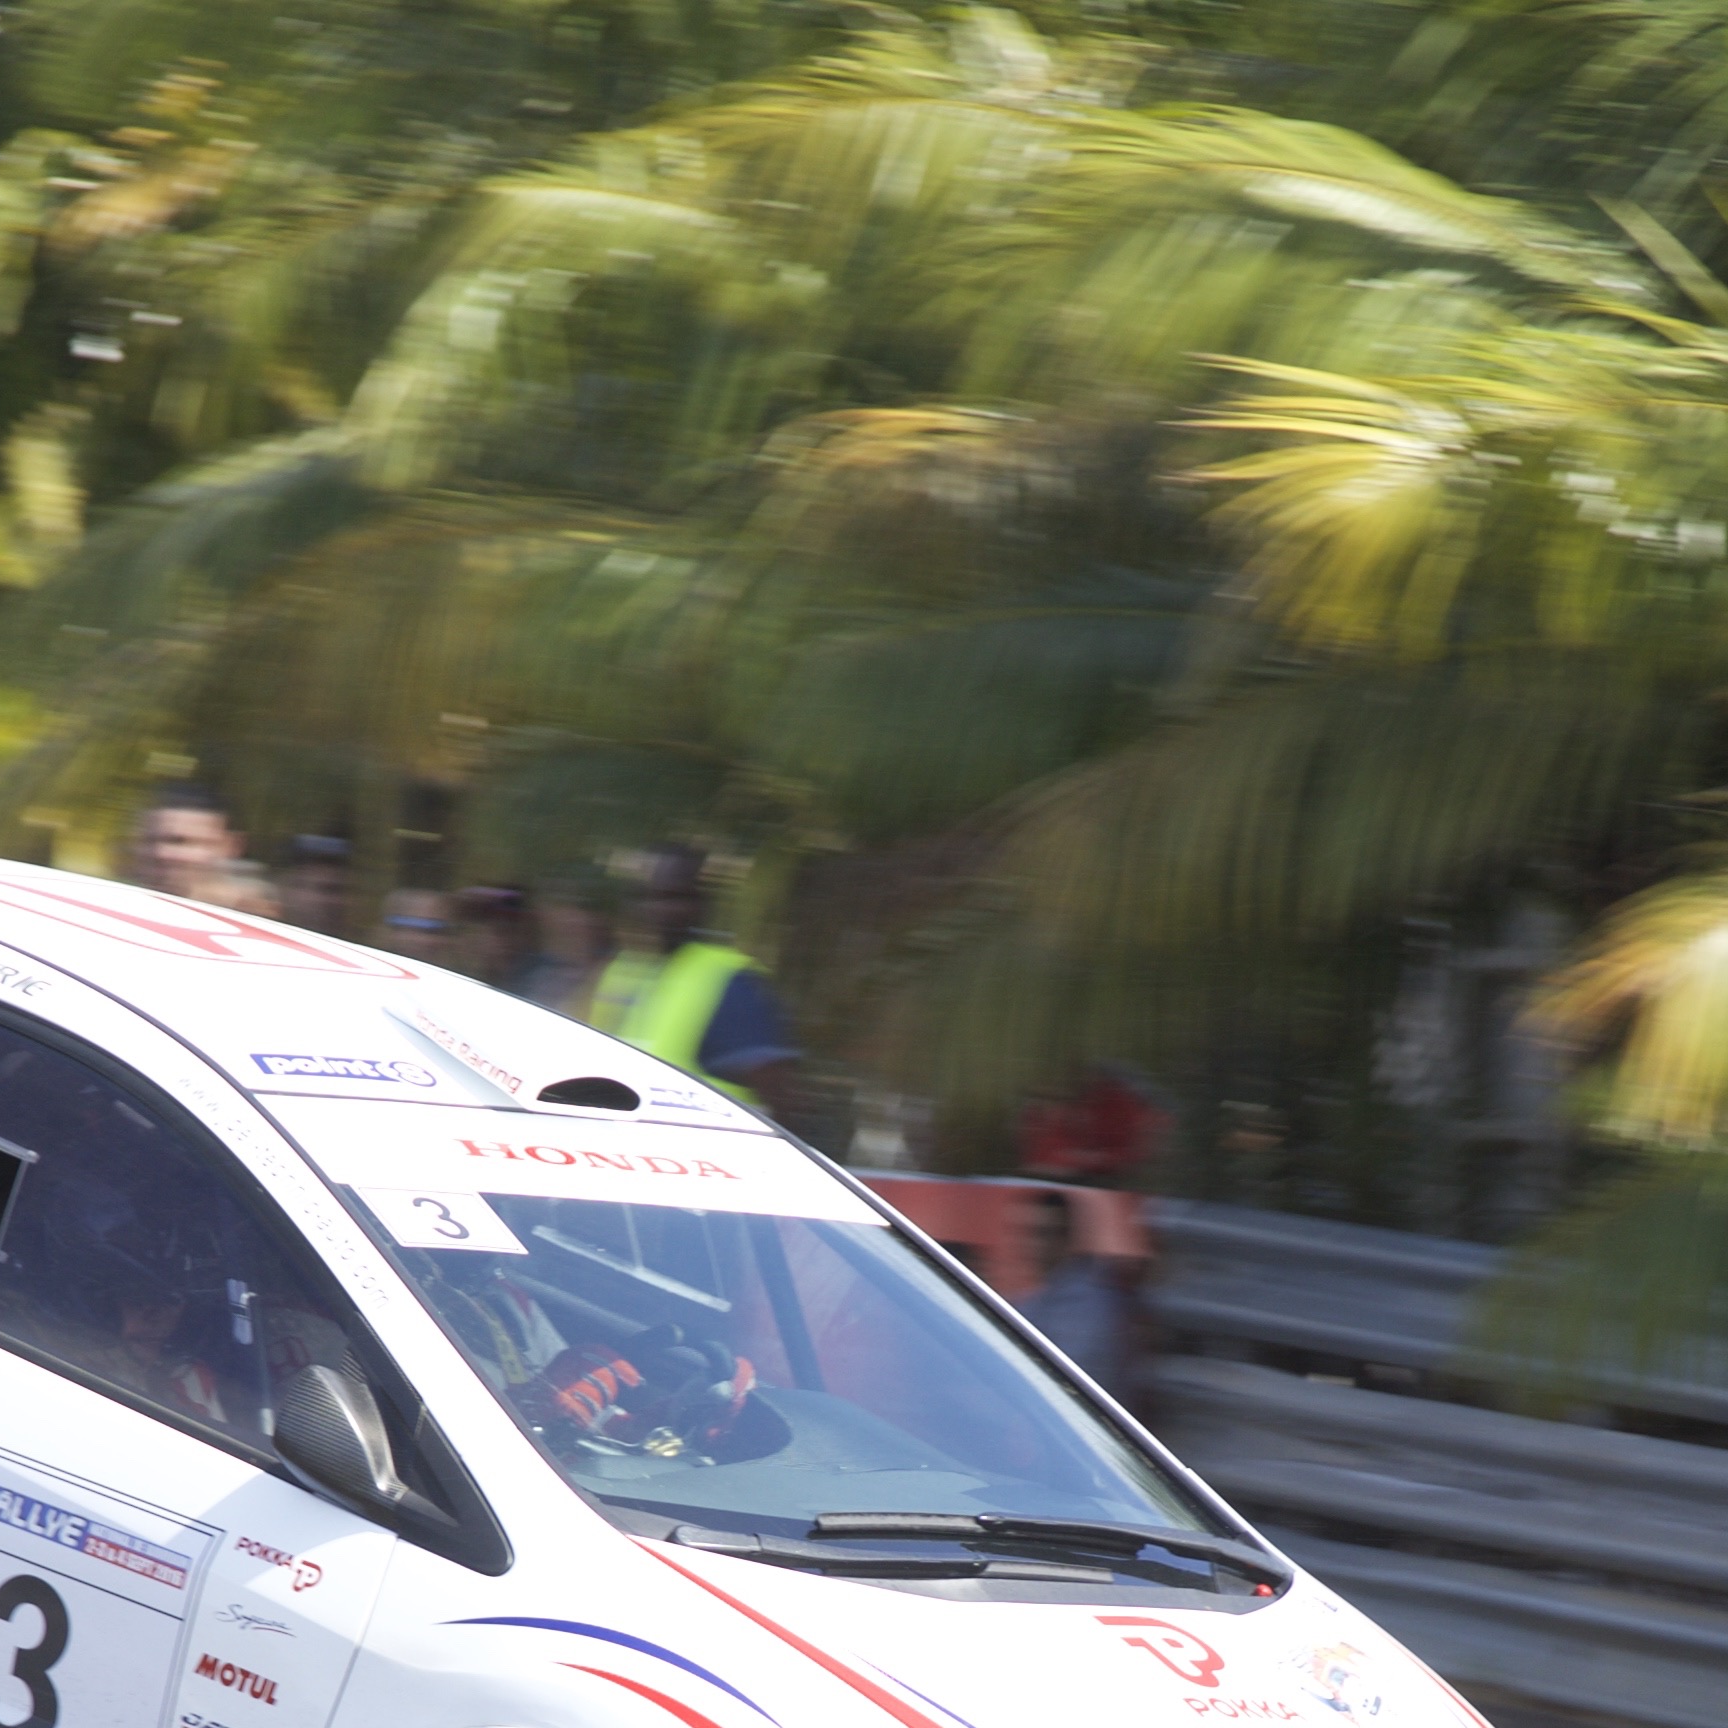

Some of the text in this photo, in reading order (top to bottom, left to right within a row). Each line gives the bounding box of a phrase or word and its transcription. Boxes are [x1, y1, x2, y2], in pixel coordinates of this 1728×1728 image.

[454, 1137, 743, 1181] HONDA
[413, 1196, 470, 1241] 3
[194, 1652, 279, 1706] MOTUL
